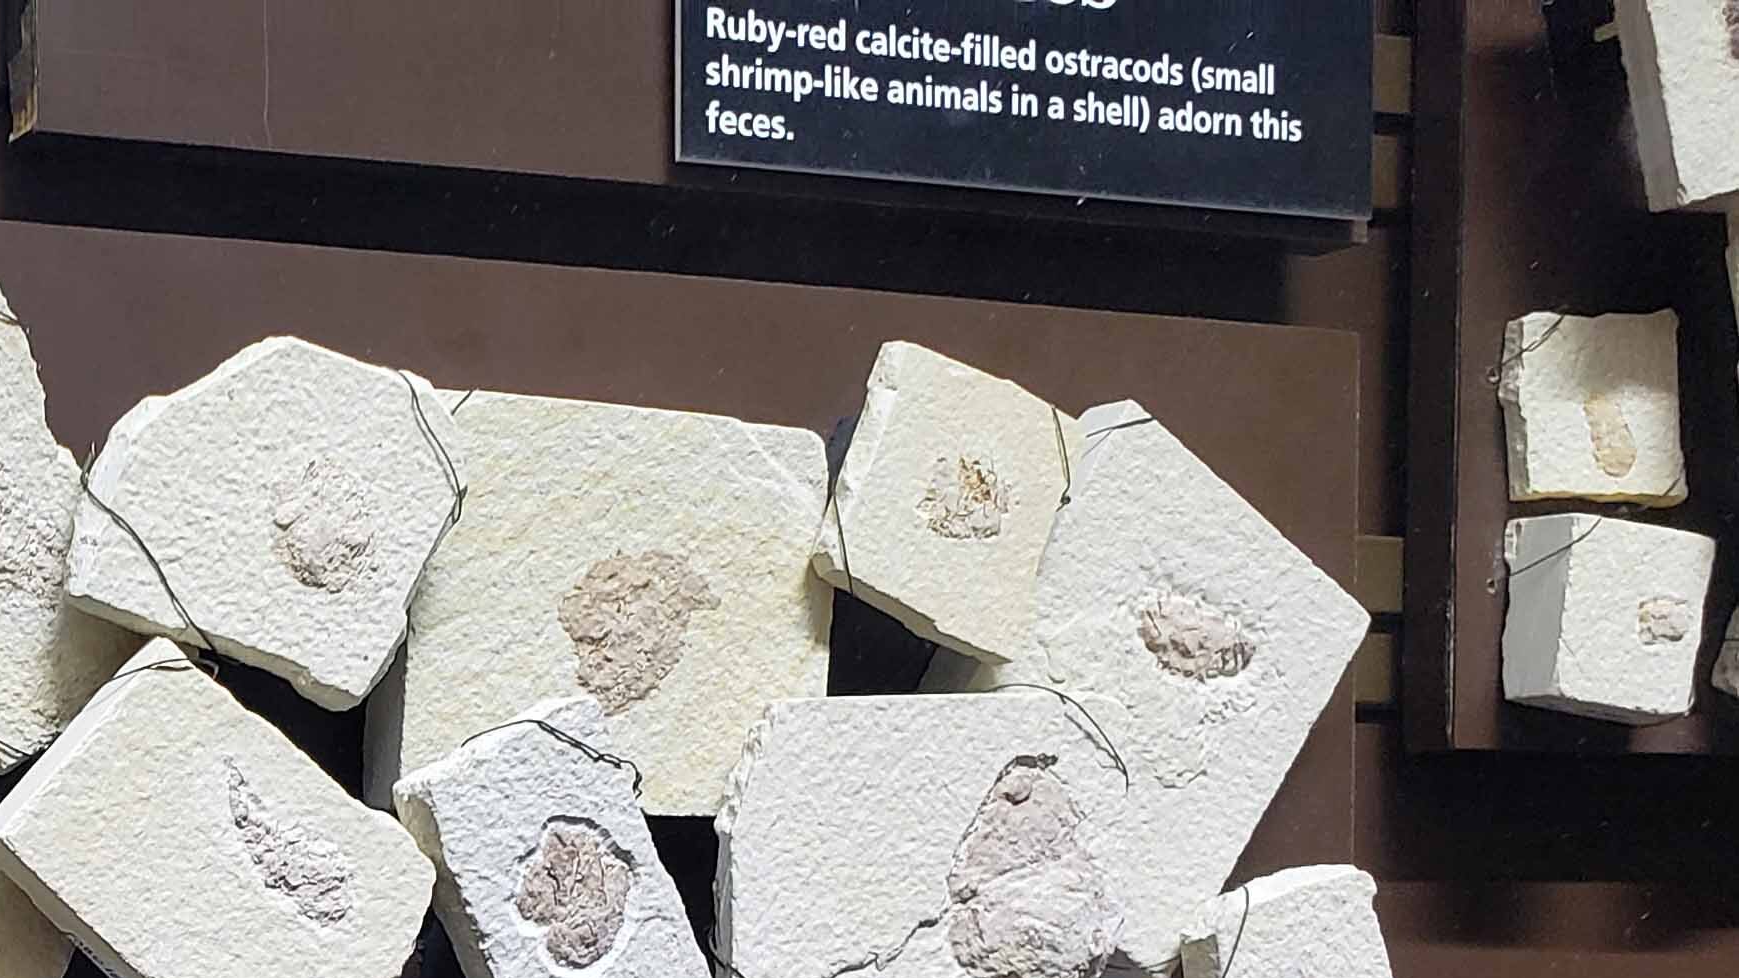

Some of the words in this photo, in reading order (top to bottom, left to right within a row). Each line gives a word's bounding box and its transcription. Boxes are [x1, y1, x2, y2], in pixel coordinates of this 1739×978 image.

[706, 6, 847, 53] Ruby-red
[855, 24, 1037, 72] calcite-filled
[1044, 48, 1184, 86] ostracods
[1191, 56, 1275, 96] (small
[705, 53, 879, 103] shrimp-like
[886, 74, 1003, 114] animals
[1011, 83, 1039, 118] in
[1047, 95, 1065, 120] a
[1073, 90, 1151, 134] shell)
[1157, 100, 1243, 137] adorn
[1249, 107, 1302, 142] this
[705, 99, 795, 141] feces.
